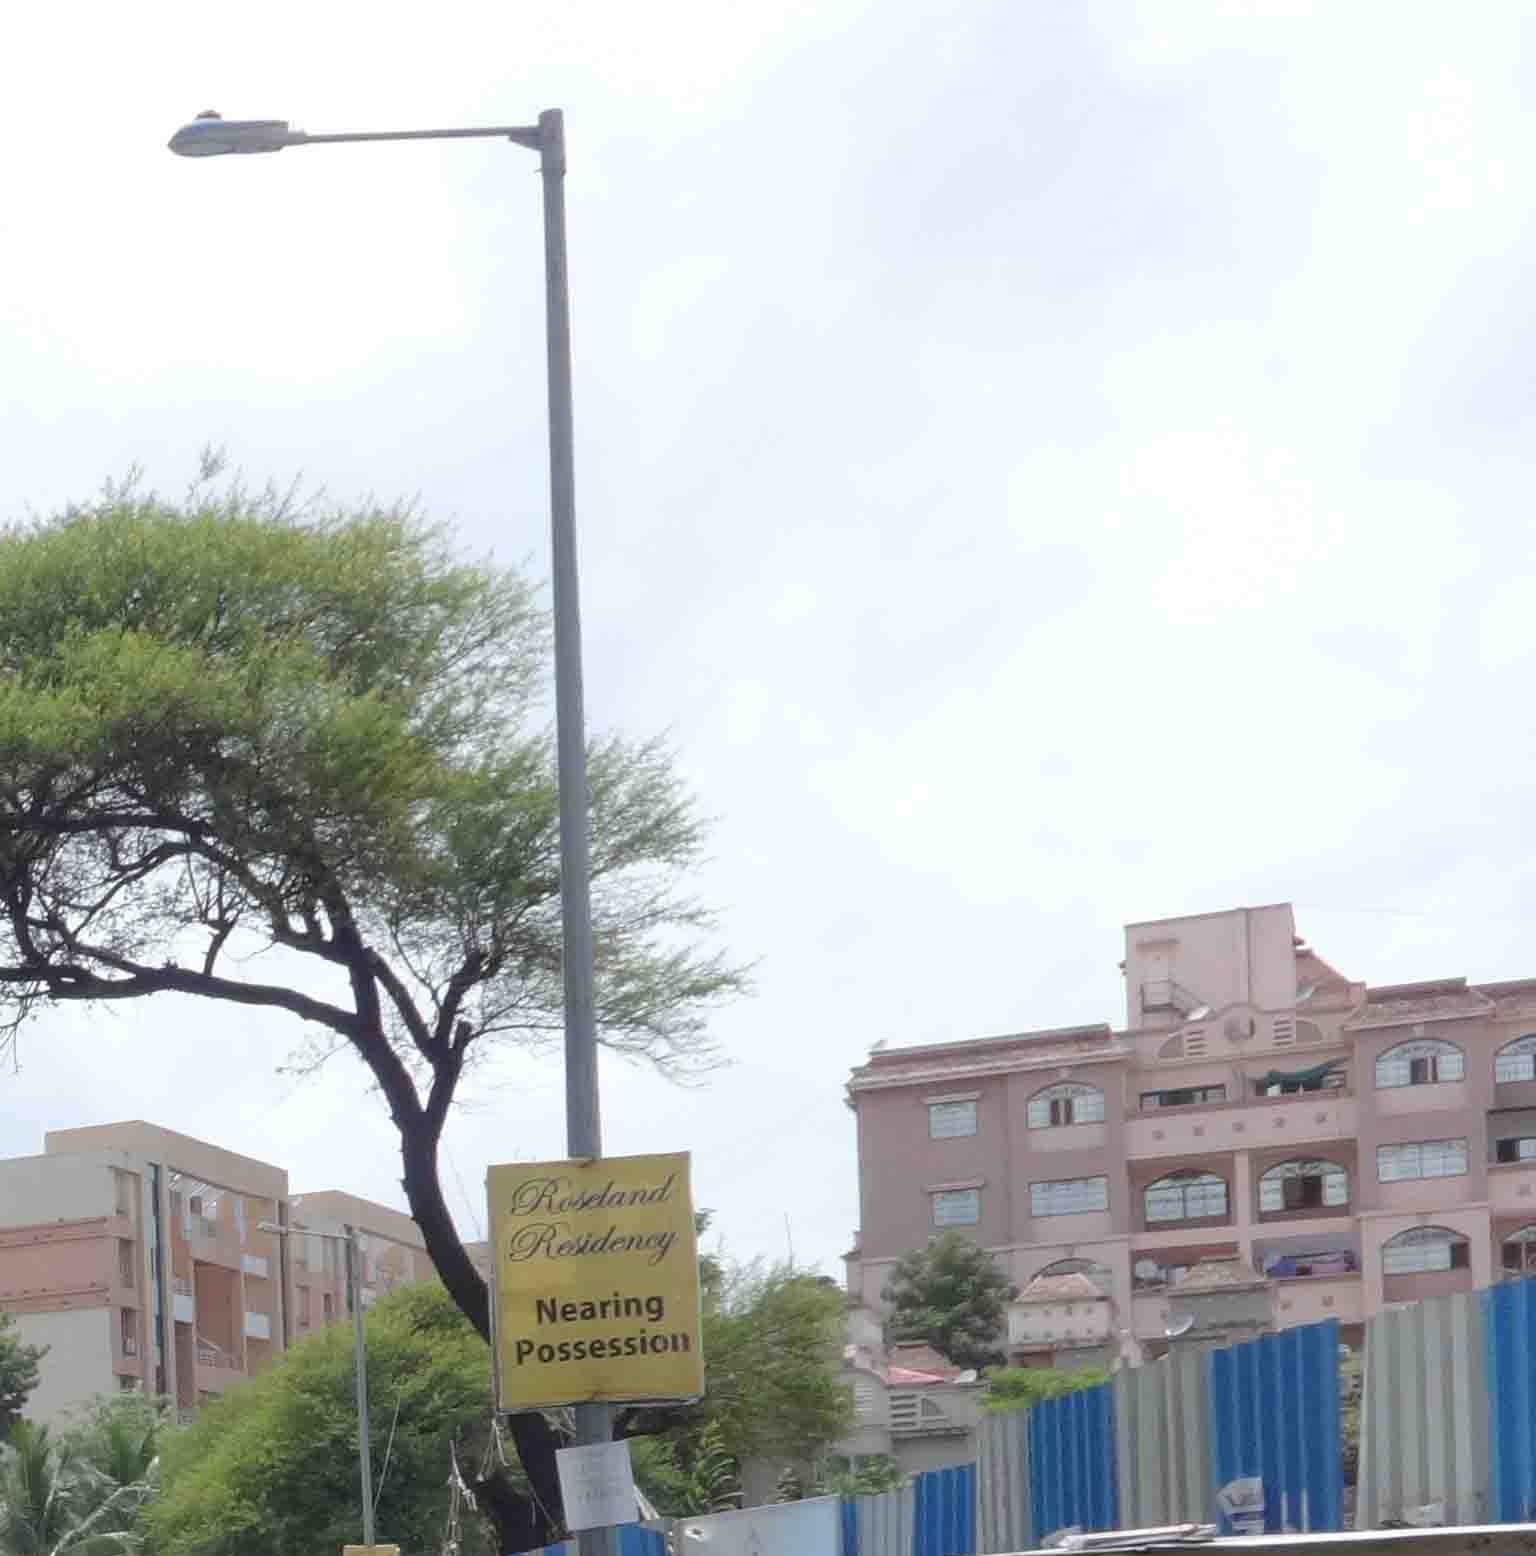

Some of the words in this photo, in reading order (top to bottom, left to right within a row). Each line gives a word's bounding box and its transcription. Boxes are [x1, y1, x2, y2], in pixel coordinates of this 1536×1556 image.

[509, 1171, 676, 1216] Roseland
[509, 1221, 678, 1266] Residency
[536, 1291, 665, 1326] Nearing
[515, 1329, 690, 1366] Possession
